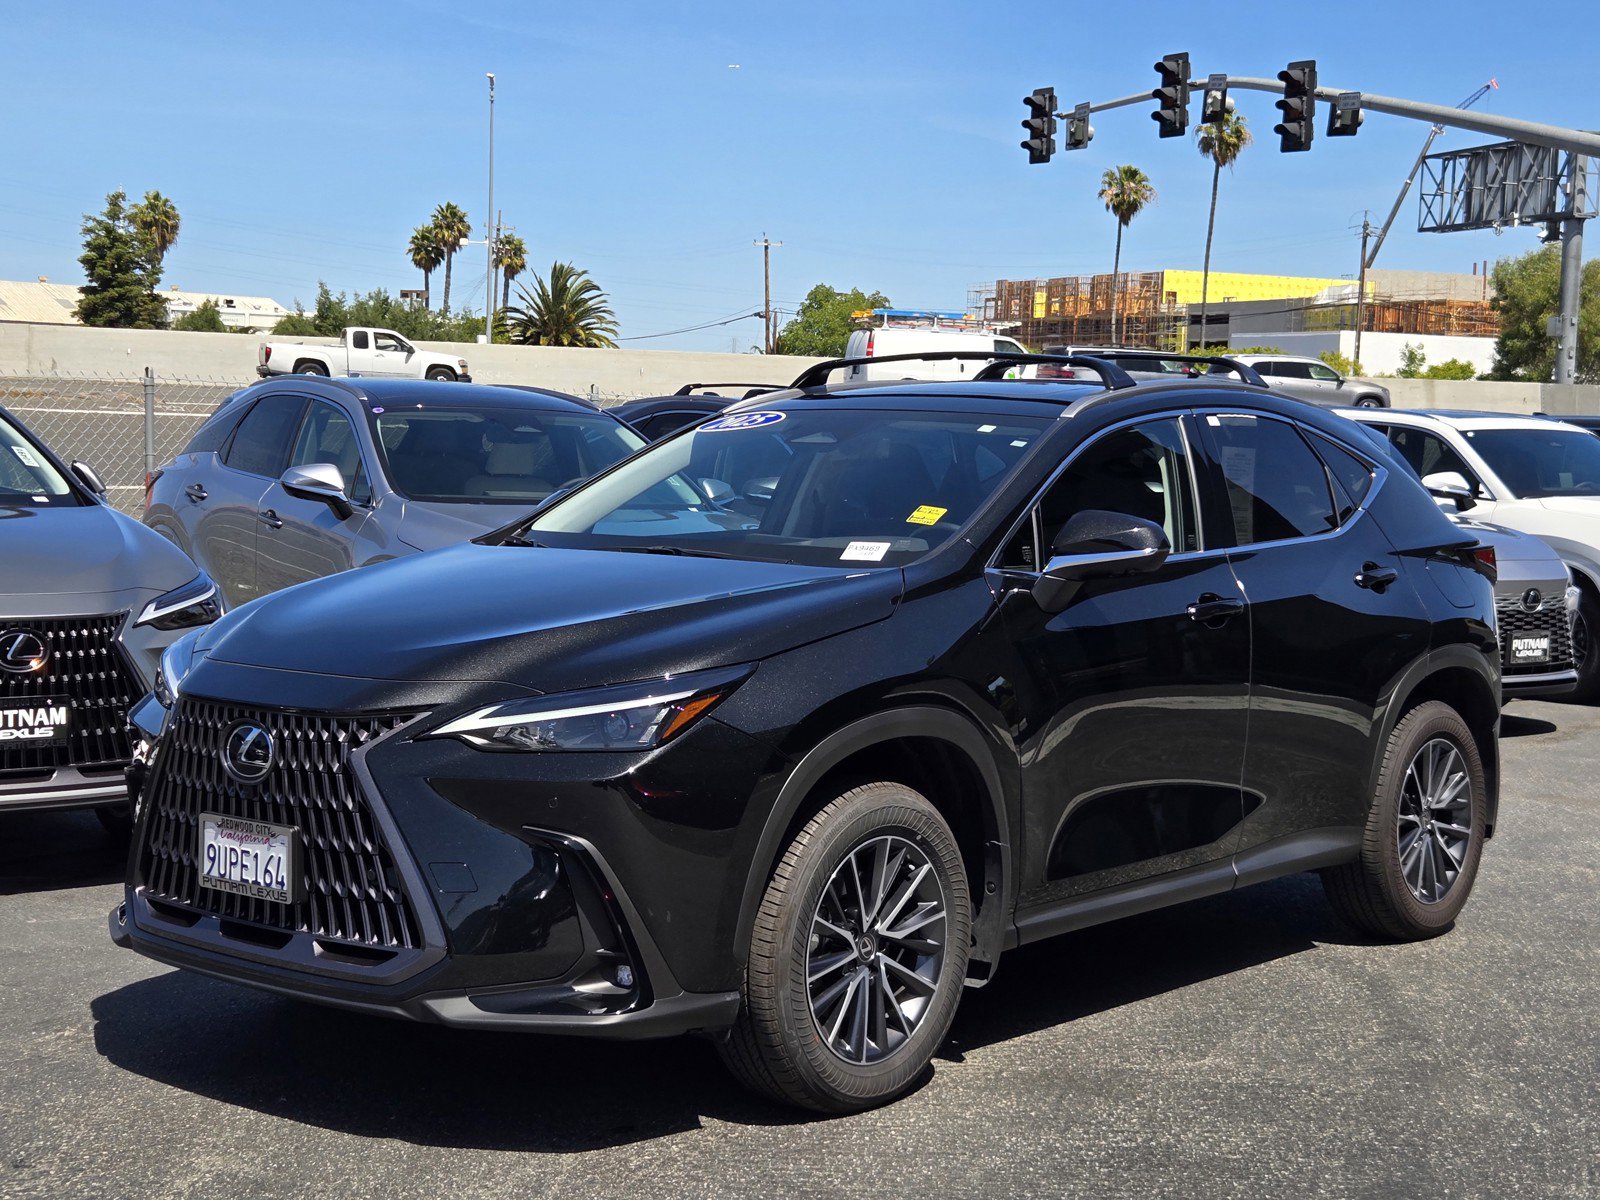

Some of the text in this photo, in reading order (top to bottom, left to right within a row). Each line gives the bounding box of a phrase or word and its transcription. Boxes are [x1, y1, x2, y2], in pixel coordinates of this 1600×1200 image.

[1512, 638, 1548, 651] PUTNAM
[221, 818, 271, 835] REDWOOD CITY
[206, 843, 285, 891] 9UPE164
[202, 875, 288, 902] PUTNAM LEXUS
